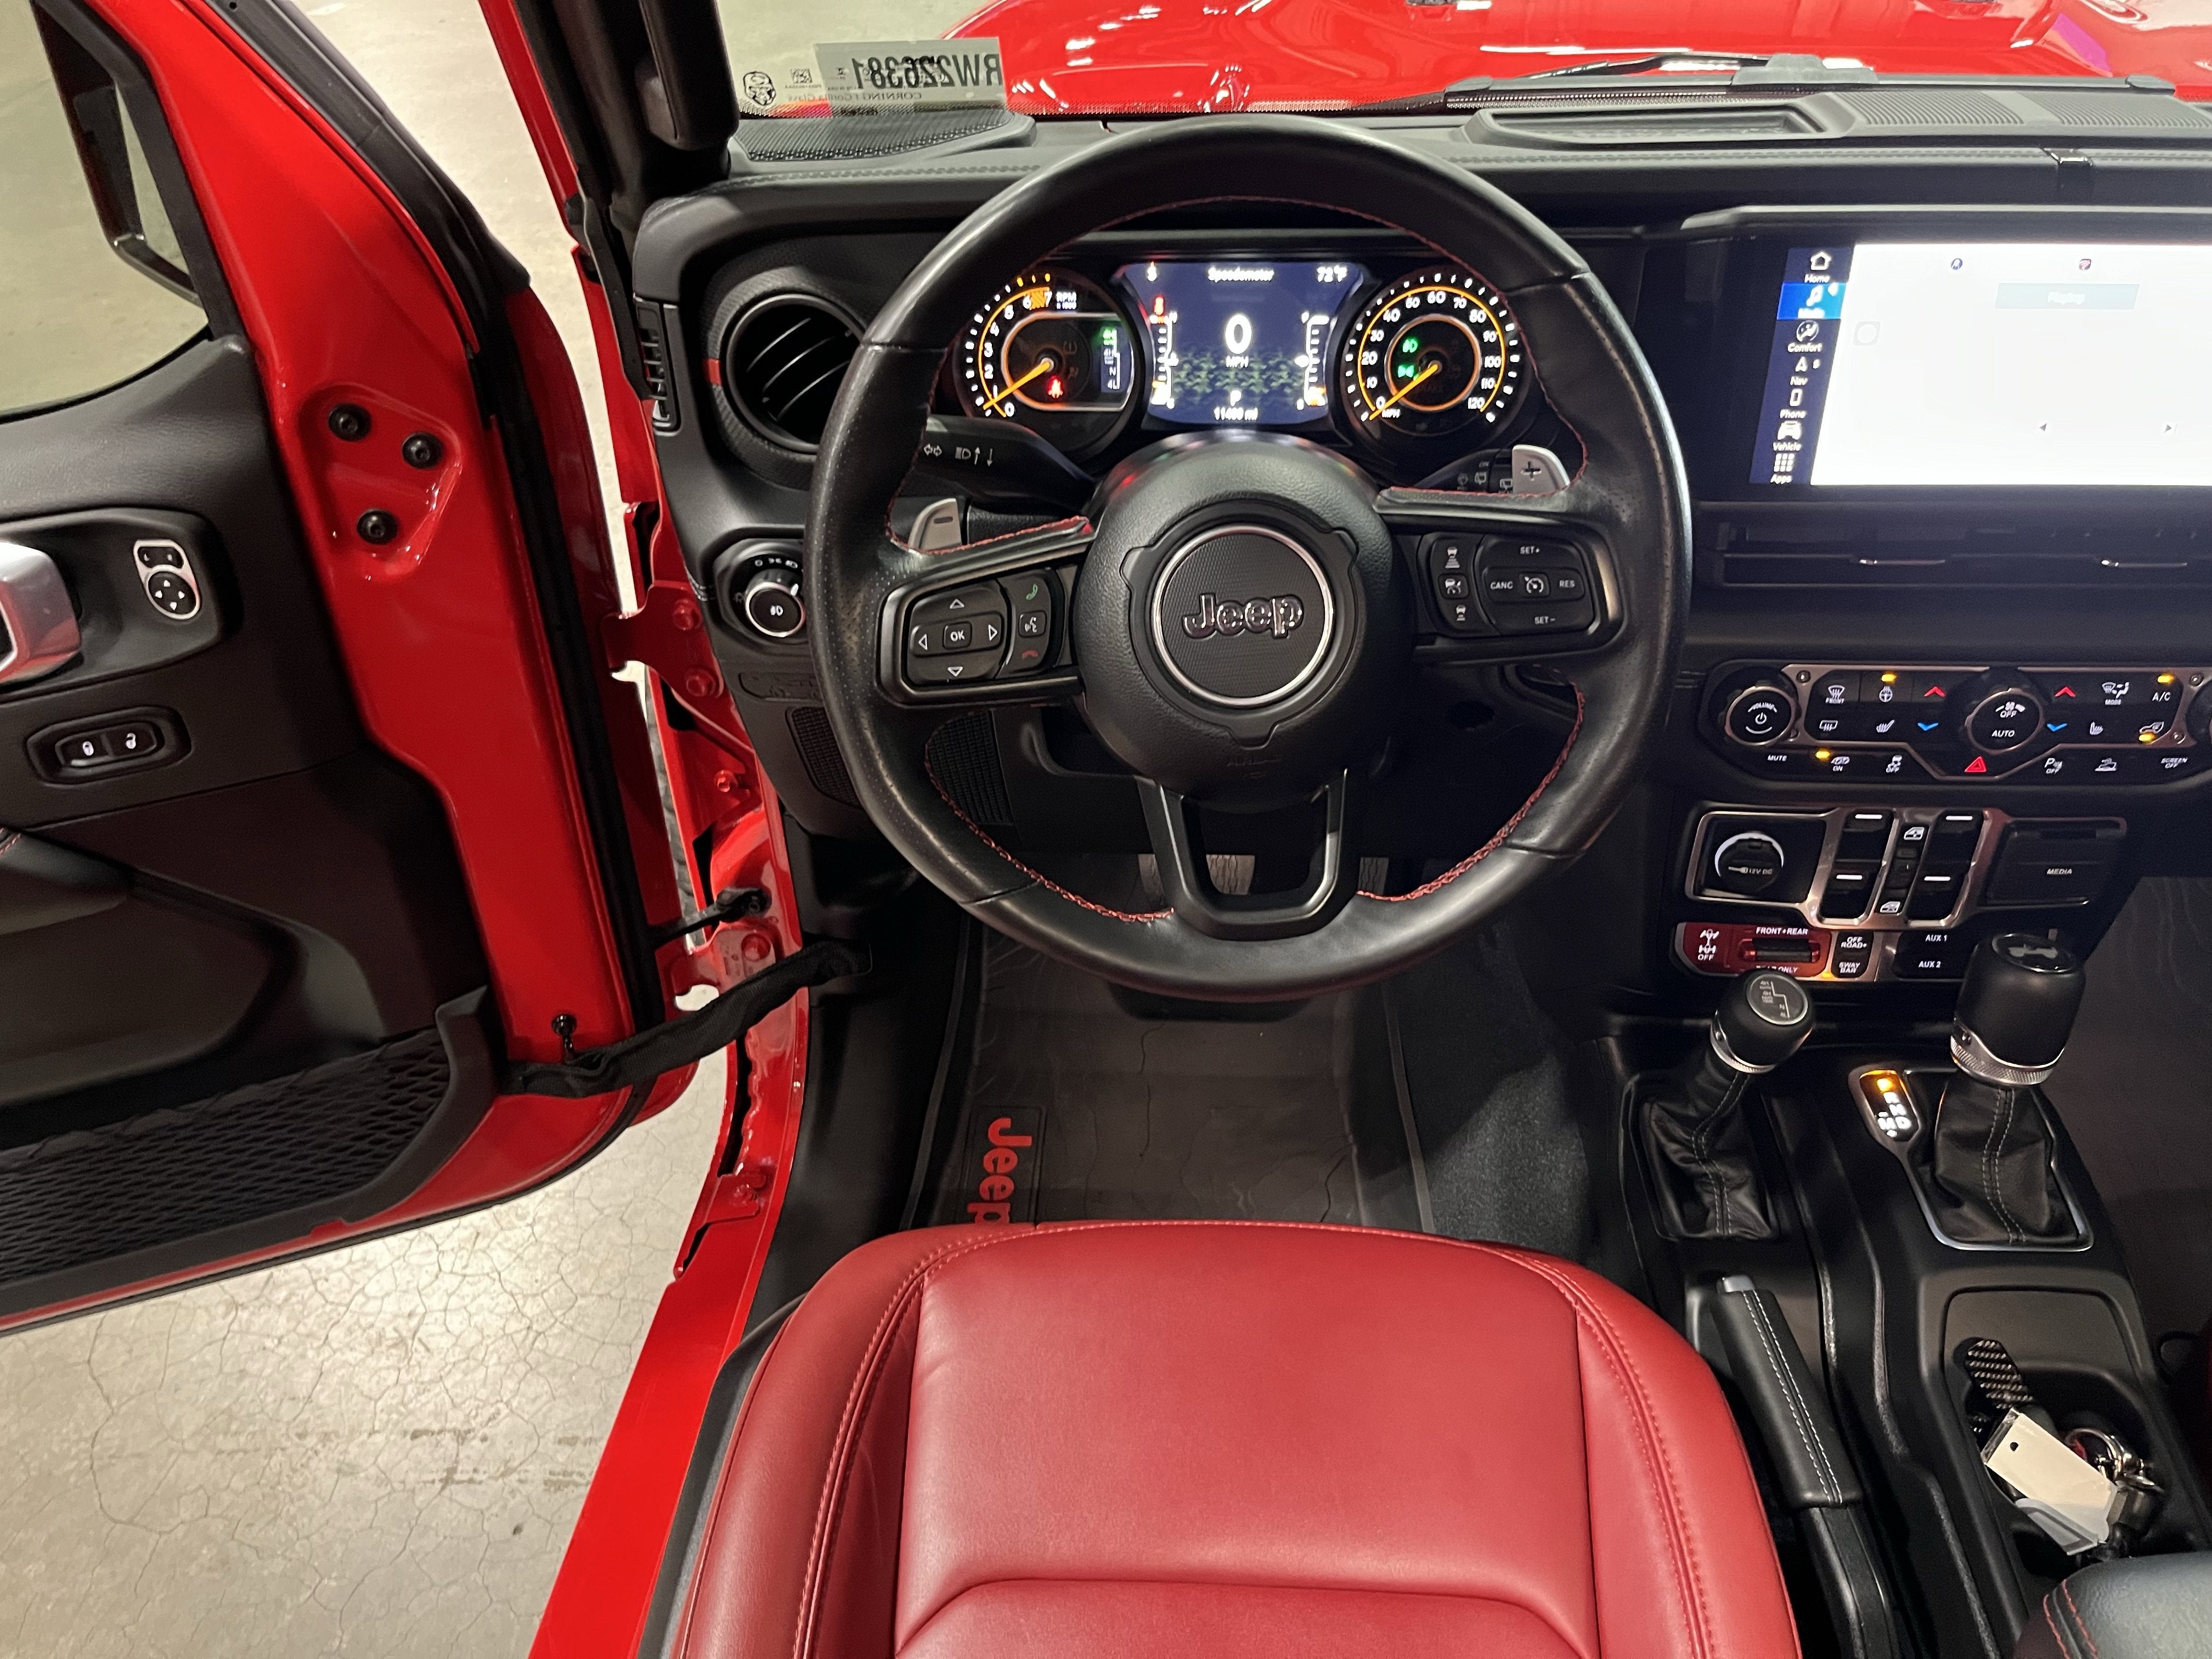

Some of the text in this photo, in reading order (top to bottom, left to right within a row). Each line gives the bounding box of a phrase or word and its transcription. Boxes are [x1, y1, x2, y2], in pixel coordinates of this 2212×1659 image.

[1804, 274, 1830, 284] Home
[1426, 291, 1447, 304] 60
[1453, 296, 1467, 309] 70
[1383, 308, 1401, 323] 40
[1469, 309, 1487, 323] 80
[1225, 313, 1252, 354] 0
[1370, 329, 1385, 342] 30
[1483, 330, 1496, 342] 90
[1787, 343, 1822, 354] Comfort
[1225, 356, 1250, 369] MPH
[1361, 351, 1378, 366] 20
[1484, 356, 1502, 368] 100
[1367, 376, 1378, 389] 10
[1481, 377, 1496, 390] 110
[1790, 376, 1808, 386] Nav
[1468, 397, 1485, 410] 120
[1779, 409, 1807, 420] Phone
[1490, 580, 1514, 590] CANC
[1559, 579, 1576, 588] RES
[1182, 592, 1304, 639] Jeep
[950, 629, 966, 642] OK
[2152, 691, 2171, 702] A/C
[2000, 710, 2017, 719] OFF
[1925, 934, 1948, 943] AUX 1
[1697, 953, 1714, 962] OFF
[1936, 960, 1942, 968] 2
[1895, 1116, 1912, 1130] D
[967, 1117, 1033, 1226] Jeep
